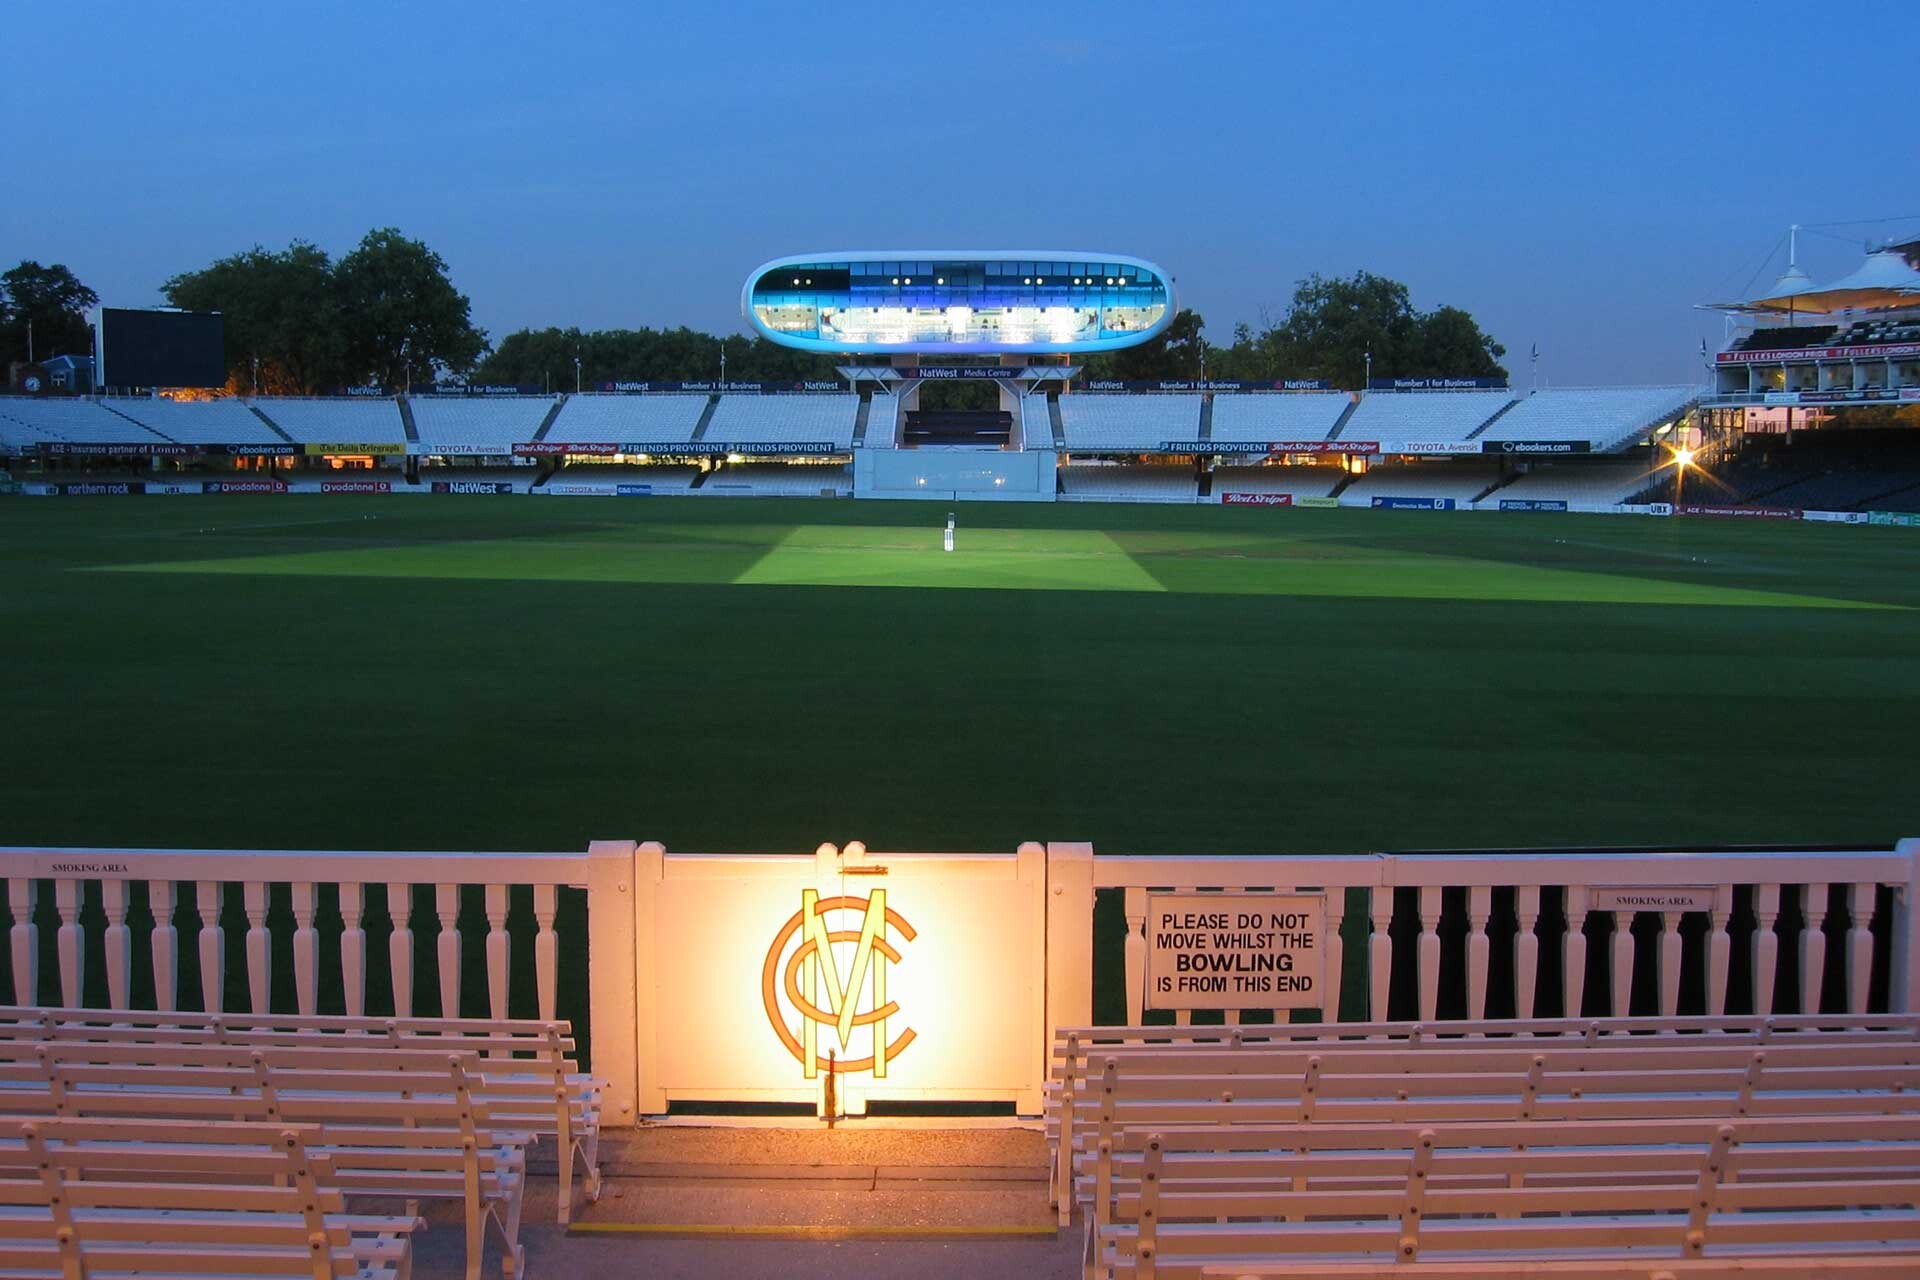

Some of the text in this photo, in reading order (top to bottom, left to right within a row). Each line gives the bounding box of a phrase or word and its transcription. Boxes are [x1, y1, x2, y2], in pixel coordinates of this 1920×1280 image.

[1805, 349, 1828, 358] PRIDE
[919, 368, 1011, 378] NatWest Media Centre
[615, 382, 649, 391] NatWest
[682, 382, 709, 390] Number
[718, 382, 729, 390] for
[730, 382, 761, 390] Business
[804, 382, 838, 390] NatWest
[1089, 381, 1123, 390] NatWest
[1160, 381, 1188, 389] Number
[1196, 381, 1208, 389] for
[1209, 381, 1240, 389] Business
[1284, 381, 1319, 389] NatWest
[1394, 379, 1424, 387] Number
[1431, 379, 1442, 387] for
[1444, 379, 1477, 387] Business
[347, 387, 382, 395] NatWest
[436, 385, 463, 393] Number
[473, 385, 484, 393] for
[486, 385, 517, 393] Business
[51, 444, 65, 453] ACE
[71, 444, 107, 454] Insurance
[108, 445, 136, 455] partner
[138, 444, 147, 454] of
[240, 445, 294, 454] ebookers.com
[360, 443, 400, 453] Telegraph
[434, 445, 473, 453] TOYOTA
[628, 444, 723, 453] FRIENDS PROVIDENT
[736, 443, 833, 452] FRIENDS PROVIDENT
[1170, 443, 1268, 452] FRIENDS PROVIDENT
[1271, 443, 1323, 453] Red Stripe
[1327, 443, 1377, 453] Red Stripe
[1407, 443, 1478, 452] TOYOTA Avensis
[1515, 443, 1571, 452] ebookers.com
[67, 484, 106, 494] northern
[108, 483, 129, 494] rock
[230, 483, 271, 491] vodafone
[332, 483, 374, 491] vodafone
[450, 483, 497, 494] NatWest
[1228, 493, 1287, 505] Red Stripe
[1650, 505, 1668, 513] UBX
[1705, 507, 1733, 515] Insurance
[51, 863, 128, 872] SMOKING AREA
[1616, 896, 1694, 906] SMOKING AREA
[1162, 914, 1309, 929] PLEASE DO NOT
[1157, 933, 1313, 949] MOVE WHILST THE
[1176, 953, 1293, 972] BOWLING
[1157, 976, 1313, 992] IS FROM THIS END
